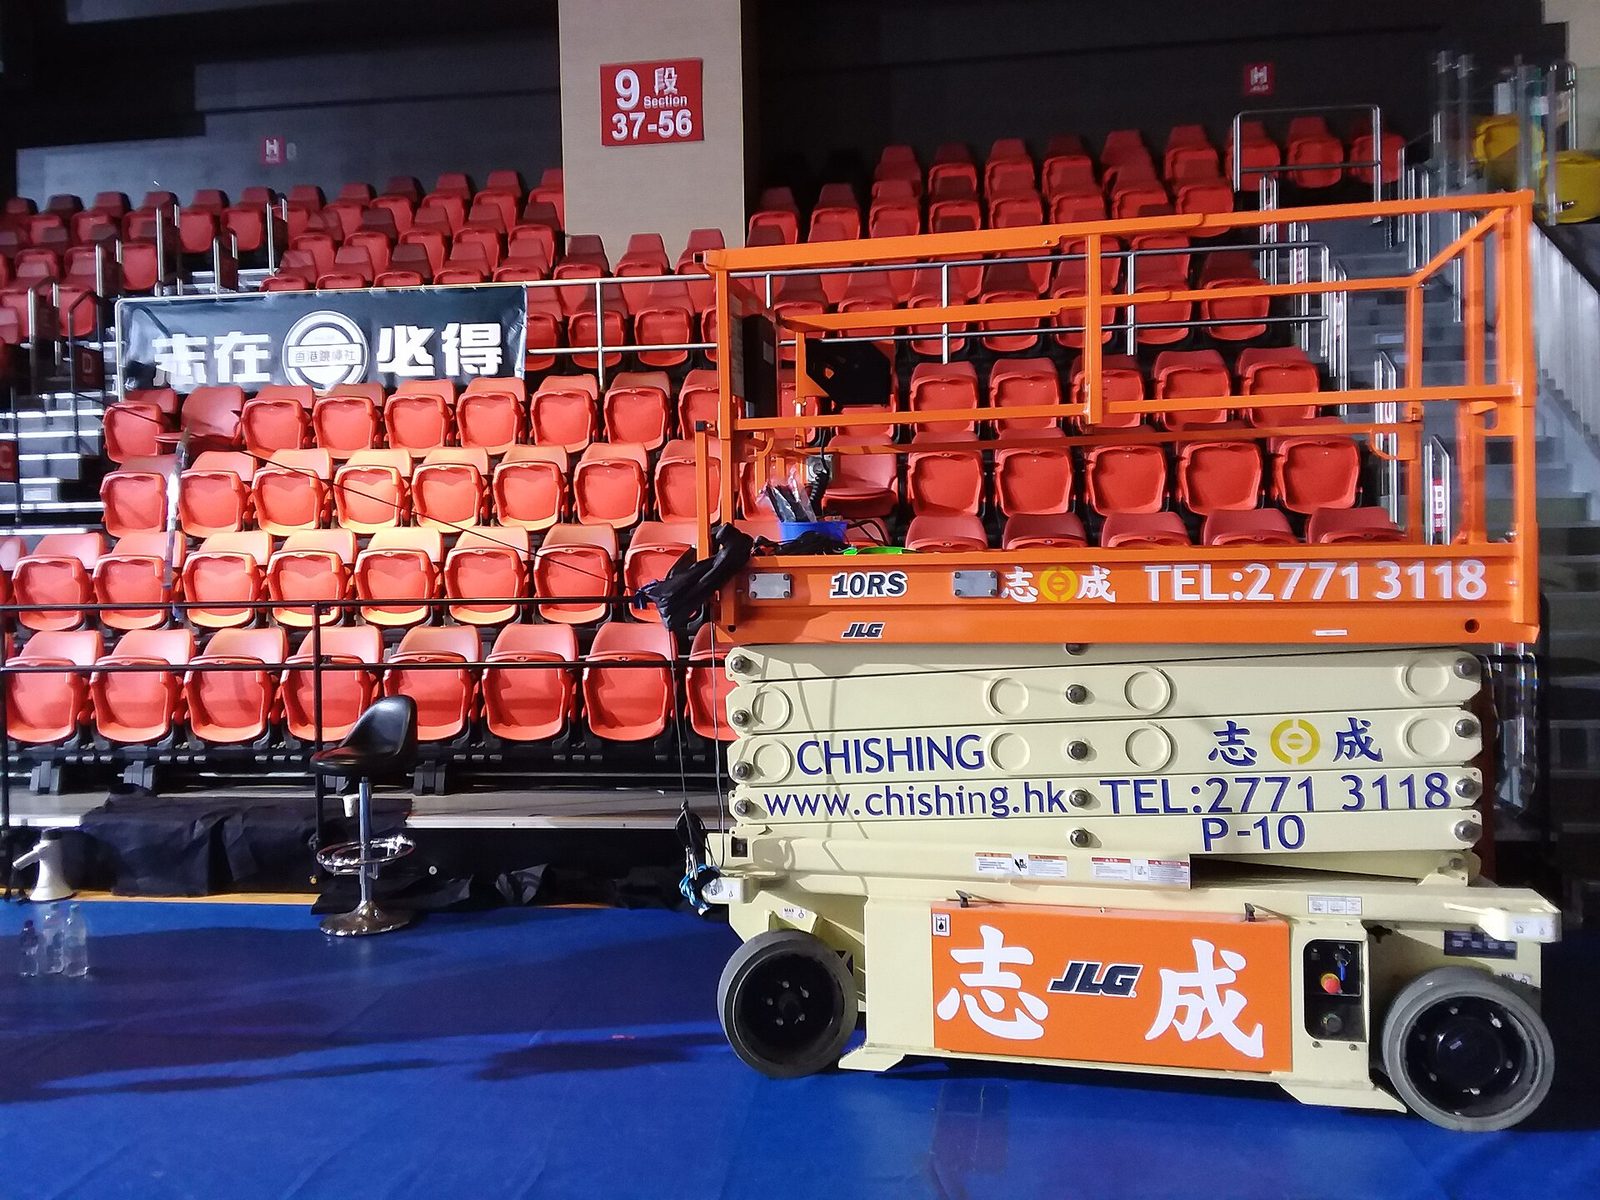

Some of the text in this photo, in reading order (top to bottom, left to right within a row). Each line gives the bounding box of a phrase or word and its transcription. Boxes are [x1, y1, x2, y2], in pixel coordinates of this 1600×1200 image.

[615, 69, 640, 110] 9
[654, 67, 677, 95] 段
[643, 96, 688, 109] Section
[611, 109, 692, 140] 37-56
[376, 323, 502, 376] 必得
[831, 571, 908, 598] 10RS
[1000, 565, 1116, 603] 志 成
[1143, 560, 1488, 602] TEL:2771 3118
[842, 622, 885, 639] JLG
[797, 734, 985, 776] CHISHING
[1208, 717, 1383, 767] 志 成
[763, 781, 1068, 819] www.chishing.hk
[1099, 772, 1451, 815] TEL:2771 3118
[1201, 814, 1307, 852] P-10
[936, 924, 1049, 1041] 志
[1047, 960, 1143, 998] JLG
[1144, 938, 1265, 1059] 成
